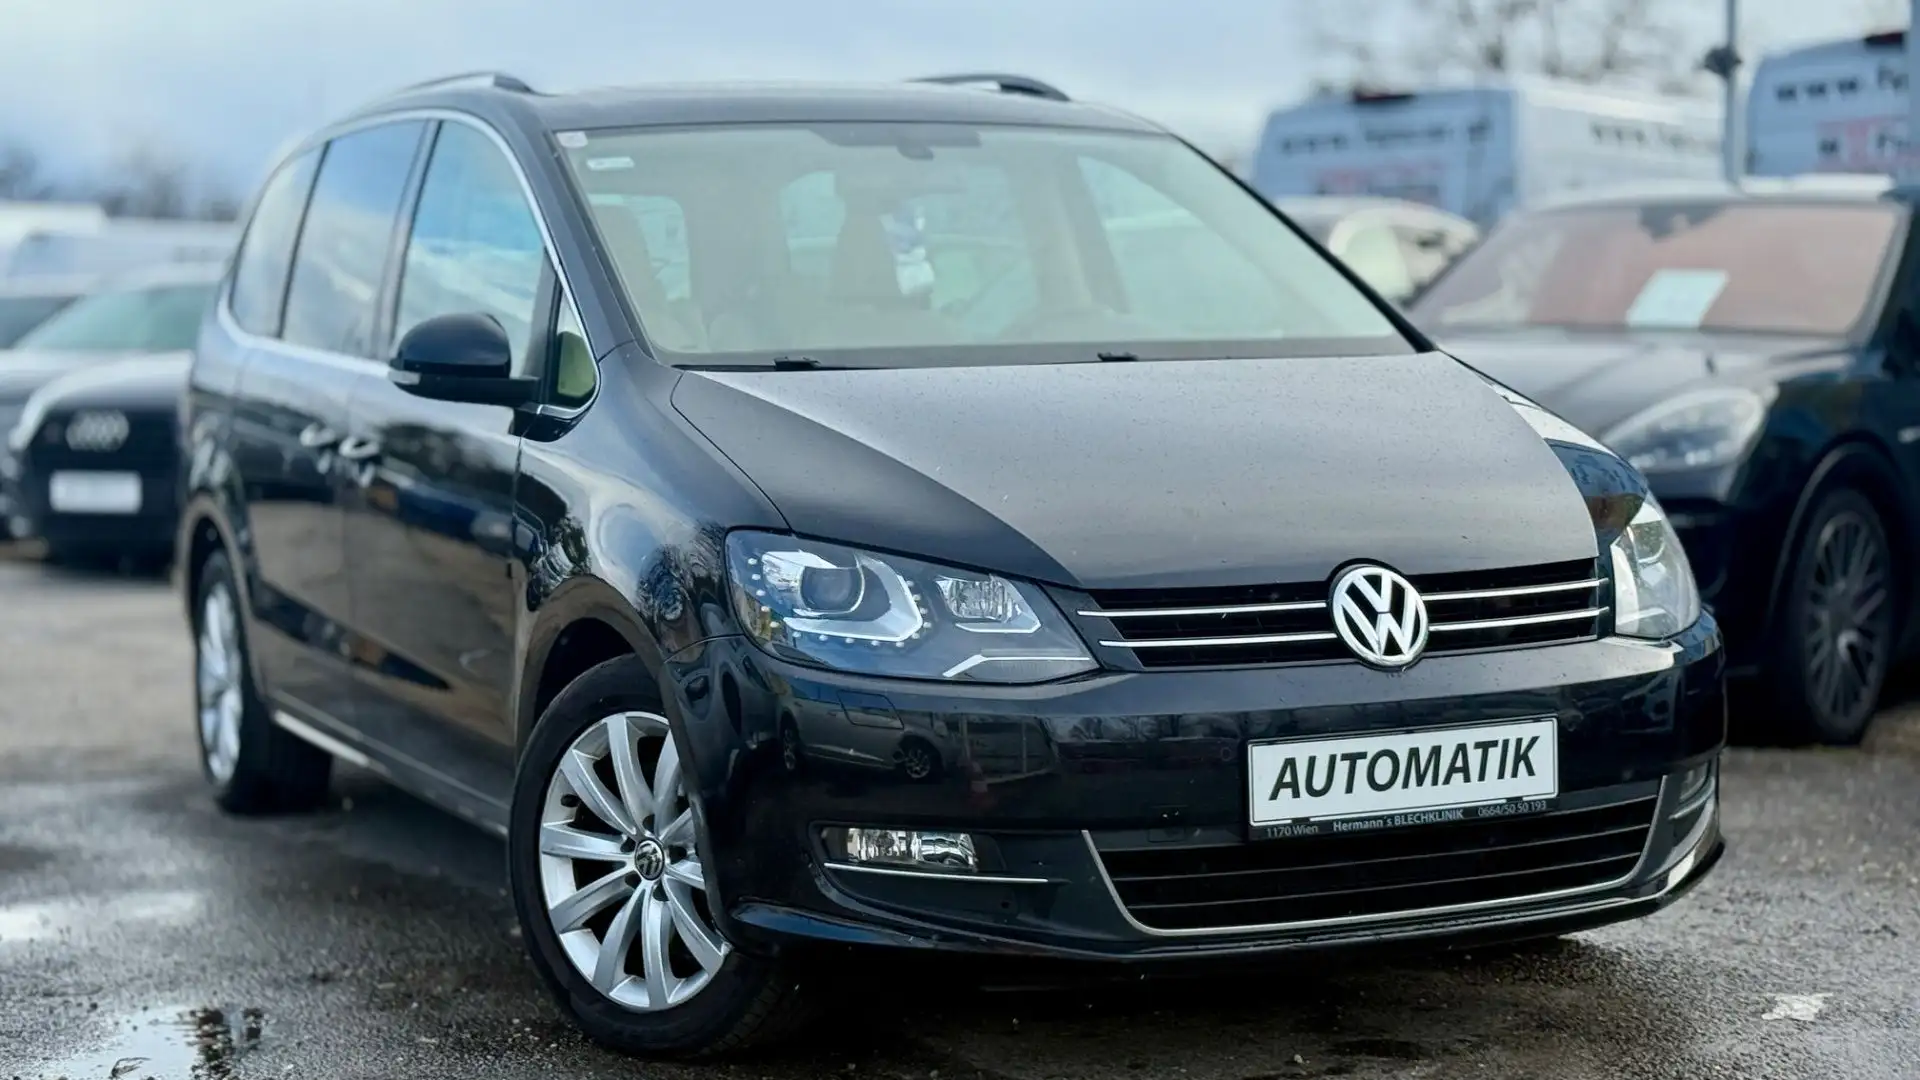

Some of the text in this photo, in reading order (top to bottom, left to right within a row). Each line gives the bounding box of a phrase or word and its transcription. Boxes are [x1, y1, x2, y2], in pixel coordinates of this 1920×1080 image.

[1332, 566, 1428, 666] VW
[1268, 735, 1541, 801] AUTOMATIK
[1266, 825, 1292, 838] 1170
[1293, 824, 1318, 836] Wien
[1394, 809, 1464, 826] BLECHKLINIK
[1530, 800, 1547, 812] 193
